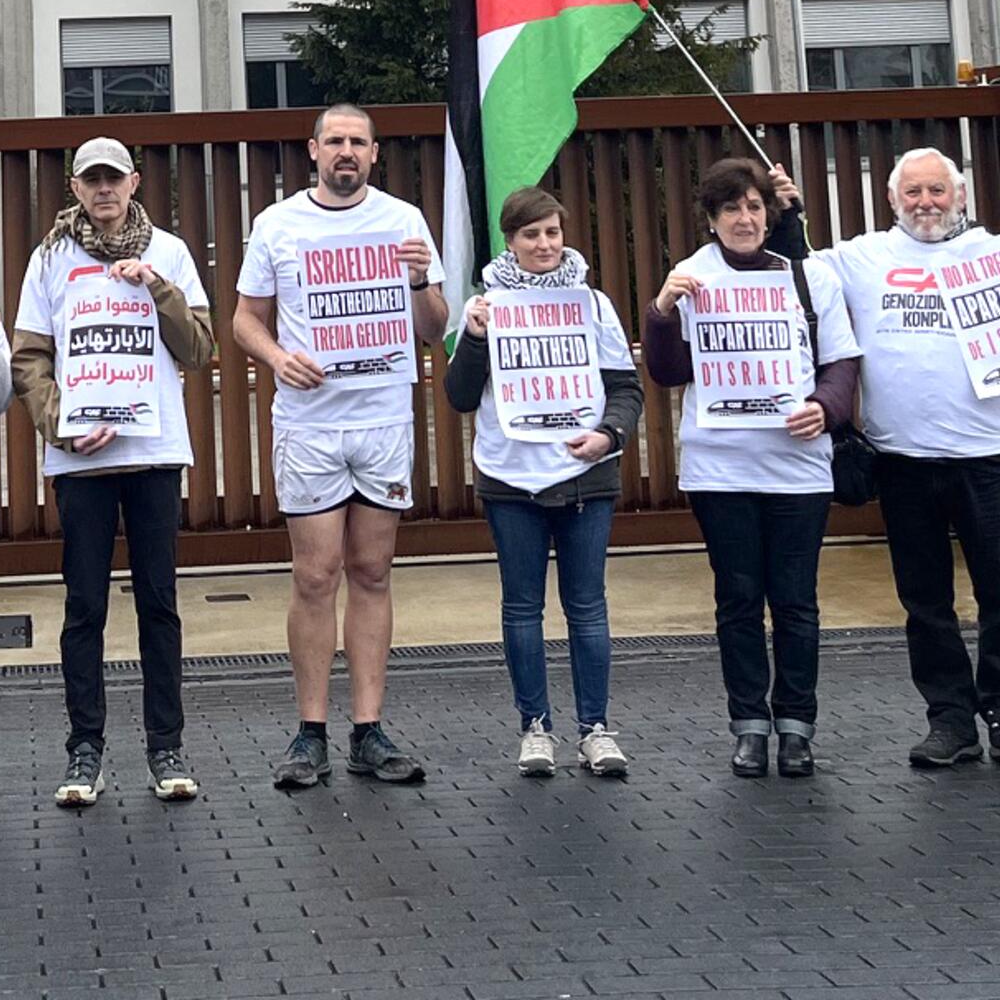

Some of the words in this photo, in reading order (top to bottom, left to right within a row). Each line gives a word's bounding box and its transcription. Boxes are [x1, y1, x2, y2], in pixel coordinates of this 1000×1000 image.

[305, 244, 402, 285] ISRAELDAR
[941, 265, 963, 289] NO
[962, 261, 981, 284] AL
[71, 295, 102, 320] قطار
[309, 288, 404, 319] APARTHEIDAREN
[695, 289, 710, 314] NO
[715, 288, 730, 313] AL
[732, 288, 767, 312] TREN
[770, 287, 788, 312] DE
[494, 306, 510, 328] NO
[514, 305, 528, 328] AL
[530, 303, 561, 327] TREN
[563, 303, 584, 325] DEL
[311, 324, 354, 351] TRENA
[356, 319, 407, 348] GELDITU
[699, 321, 790, 351] L'APARTHEID
[499, 336, 589, 369] APARTHEID
[968, 340, 985, 360] DE
[66, 361, 154, 392] الإسرائيلي
[502, 383, 515, 402] DE
[521, 374, 594, 401] ISRAEL
